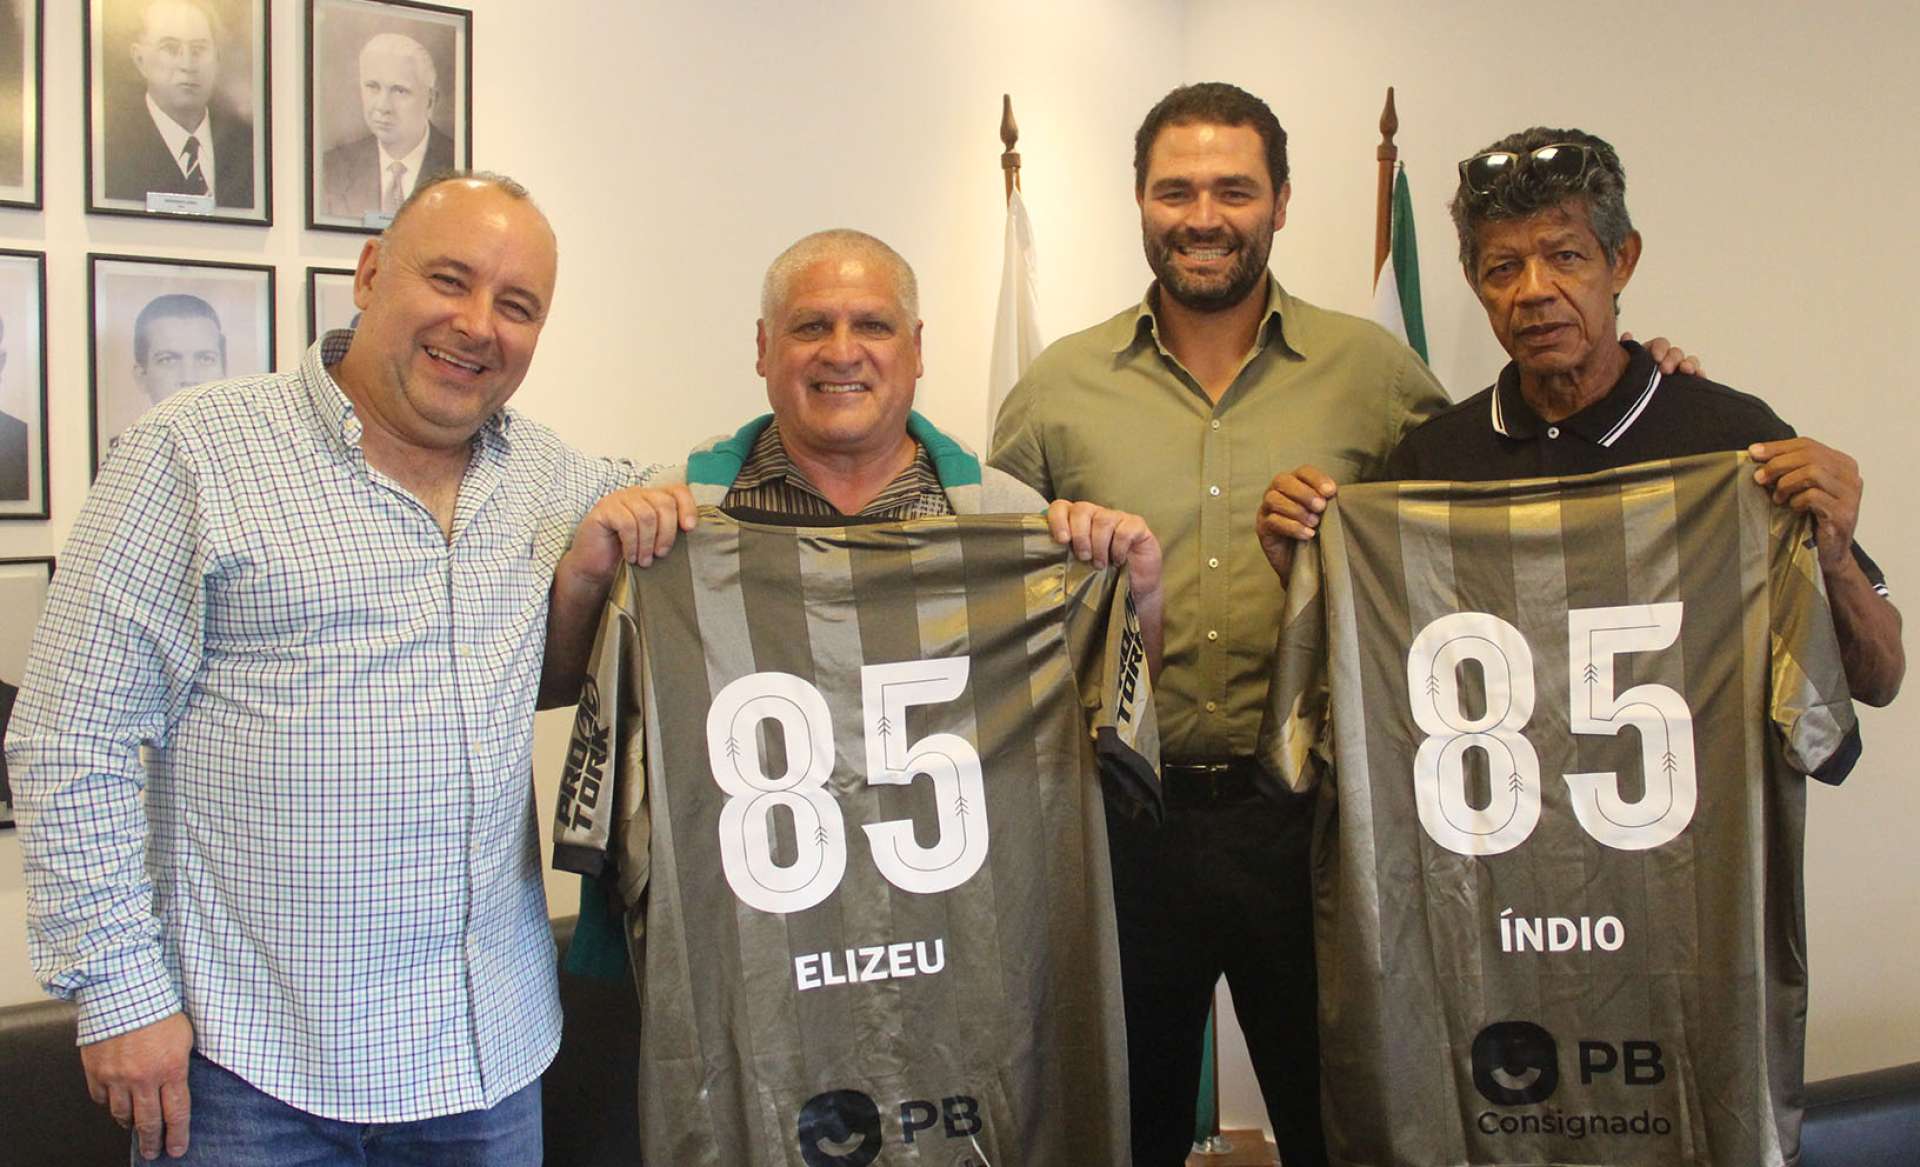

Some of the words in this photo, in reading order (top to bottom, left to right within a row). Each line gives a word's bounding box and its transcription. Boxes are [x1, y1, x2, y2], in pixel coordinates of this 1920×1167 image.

[1407, 601, 1697, 856] 85
[558, 738, 587, 827] PRO
[571, 726, 610, 831] TORK
[706, 655, 989, 914] 85
[1500, 907, 1625, 952] ÍNDIO
[795, 939, 945, 991] ELIZEU
[1579, 1040, 1665, 1085] PB
[900, 1096, 982, 1143] PB
[1477, 1110, 1671, 1139] Consignado
